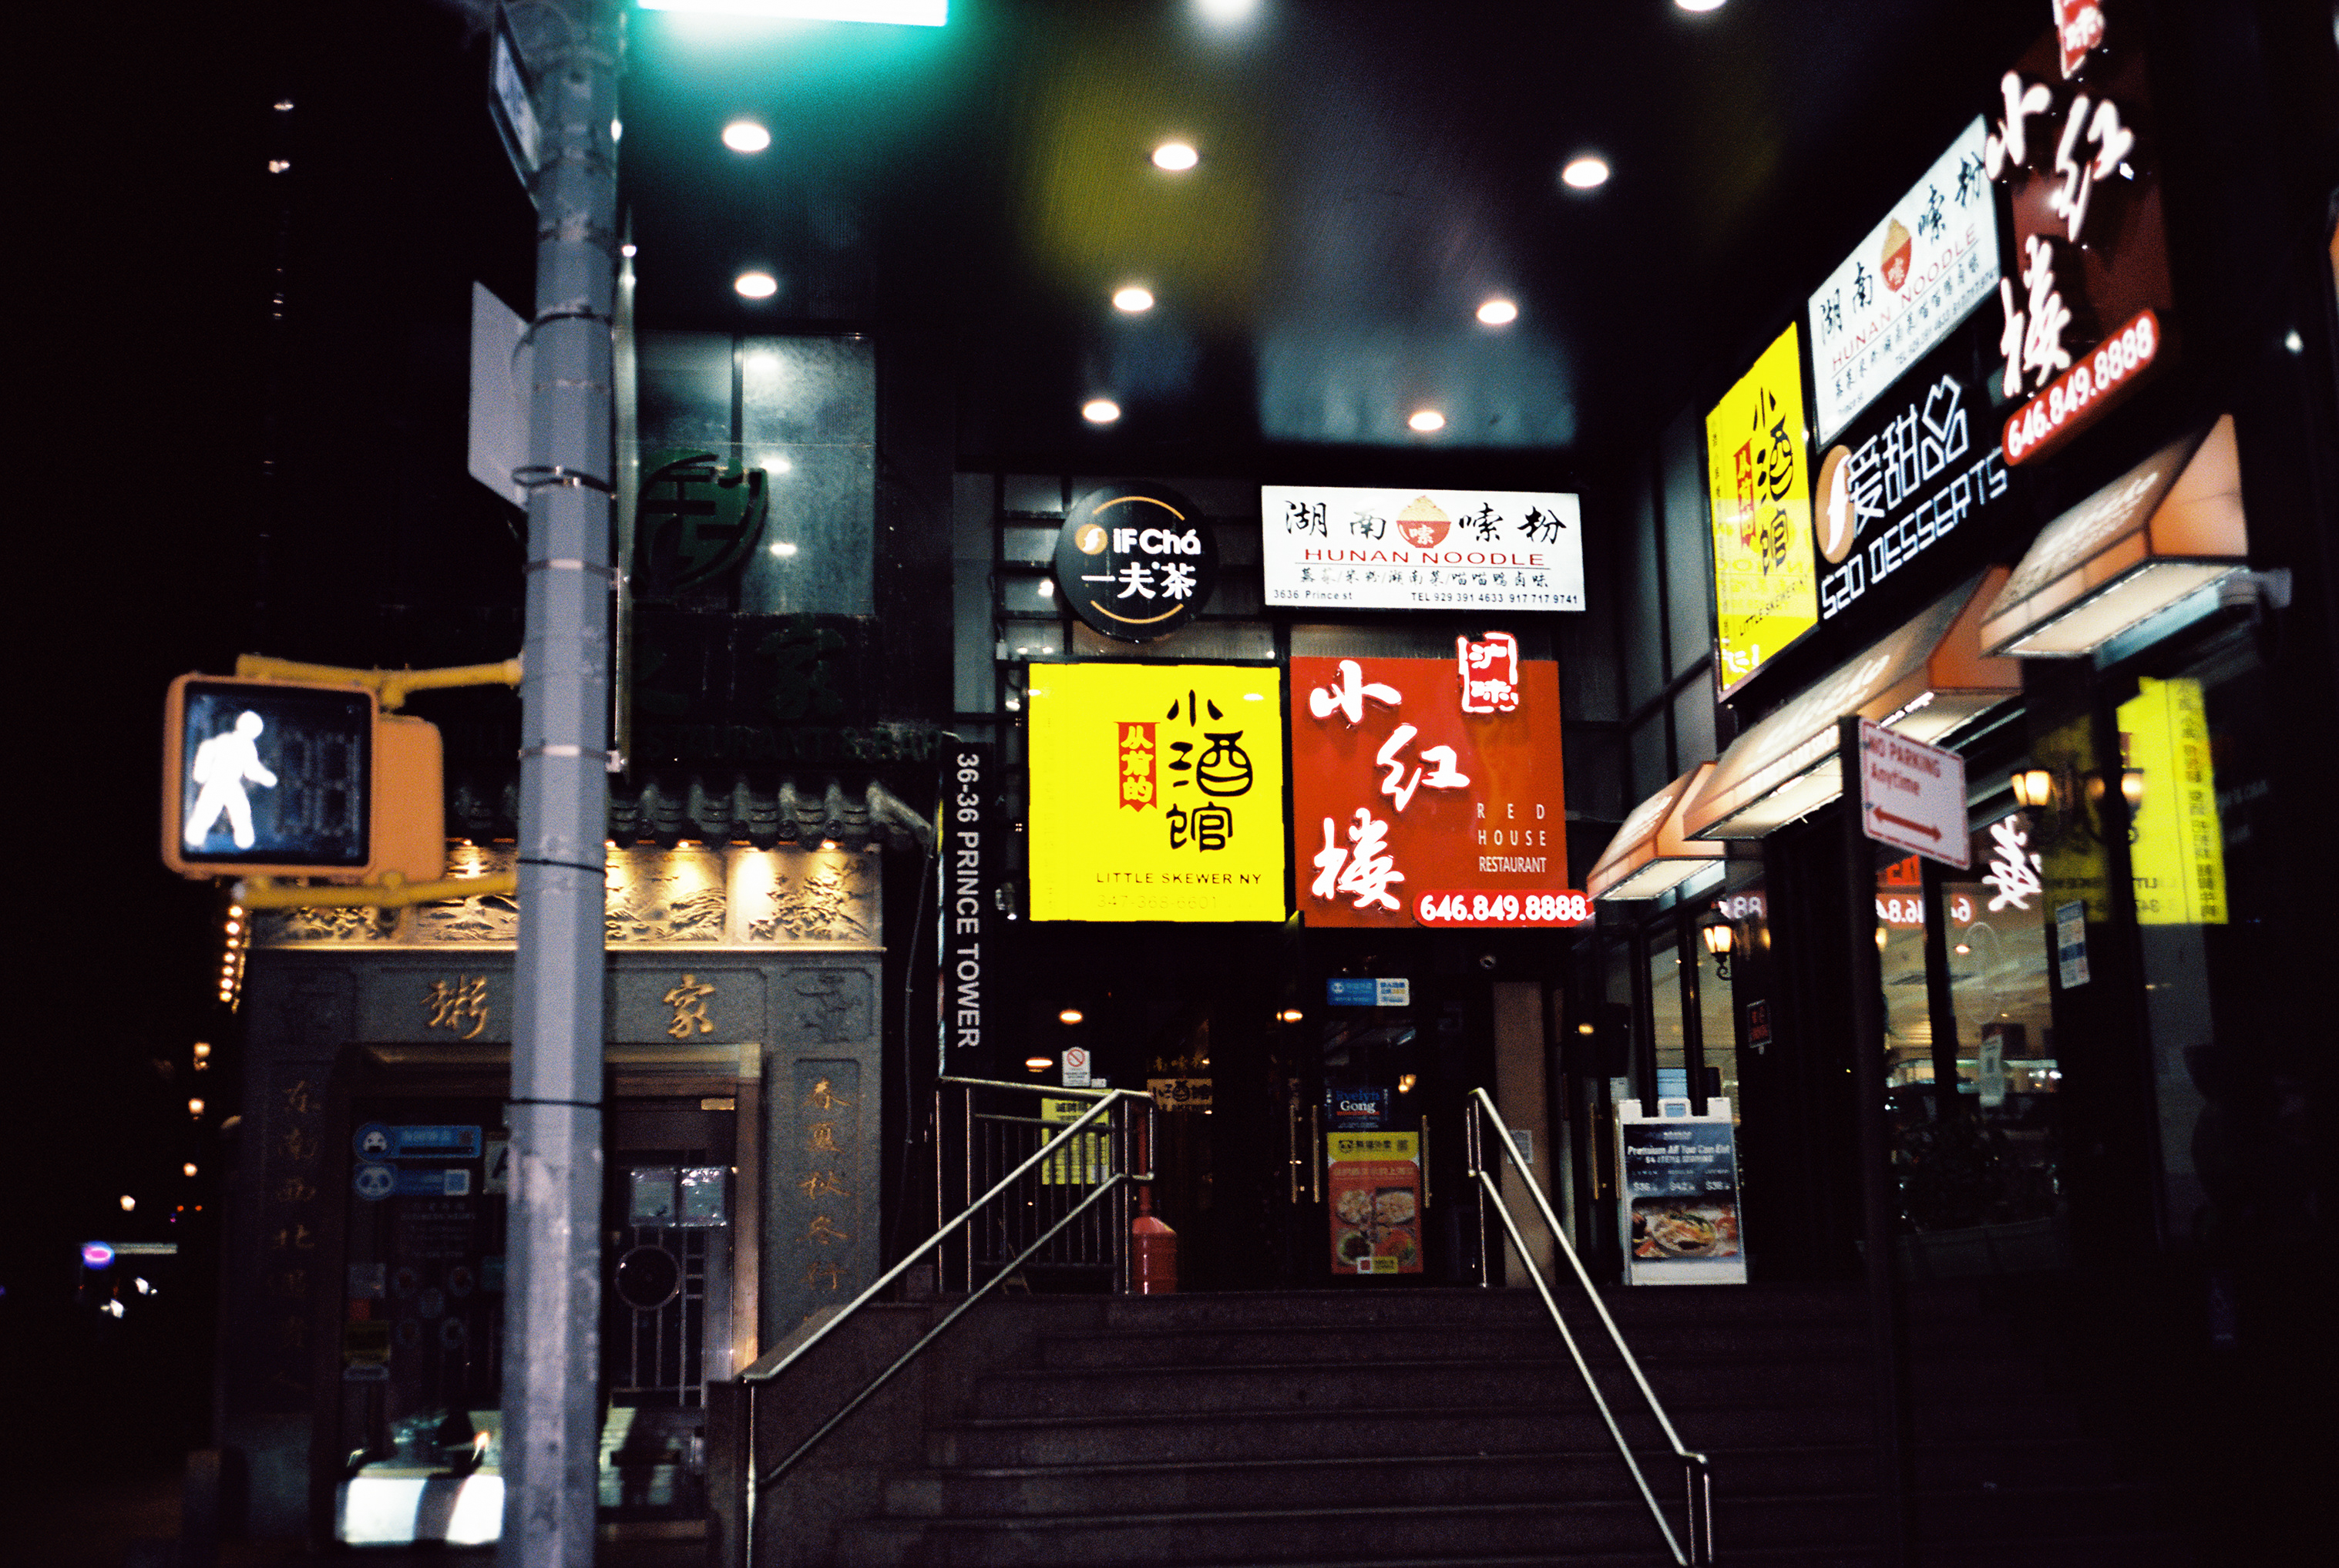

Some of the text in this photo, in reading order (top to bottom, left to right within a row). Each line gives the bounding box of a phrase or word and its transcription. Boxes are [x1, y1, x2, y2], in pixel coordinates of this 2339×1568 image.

[1832, 306, 1892, 371] HUNAN
[1900, 223, 1975, 304] NOODLE
[2008, 317, 2154, 457] 646.849.8888
[1285, 500, 1567, 545] 湖南嗦粉
[1820, 553, 1864, 619] 520
[1868, 447, 2008, 584] DESSERTS
[1305, 549, 1545, 566] HUNAN NOODLE
[1080, 561, 1198, 600] 一夫茶
[1273, 589, 1299, 599] 3636
[1306, 590, 1339, 600] Prince
[1411, 593, 1430, 602] TEL
[1433, 593, 1453, 603] 929
[1456, 593, 1474, 603] 391
[1478, 593, 1504, 603] 4633
[1509, 594, 1528, 603] 917
[1553, 595, 1578, 604] 9741
[1165, 689, 1253, 853] 小酒馆
[1889, 741, 1941, 778] PARKING
[1309, 660, 1470, 910] 小红楼
[1477, 802, 1545, 820] RED
[1477, 829, 1547, 847] HOUSE
[1097, 872, 1262, 885] LITTLE SKEWER NY
[1478, 856, 1548, 873] RESTAURANT
[956, 753, 980, 1048] 36-36 PRINCE TOWER
[1420, 895, 1587, 921] 646.849.8888
[1339, 1100, 1376, 1114] Gong
